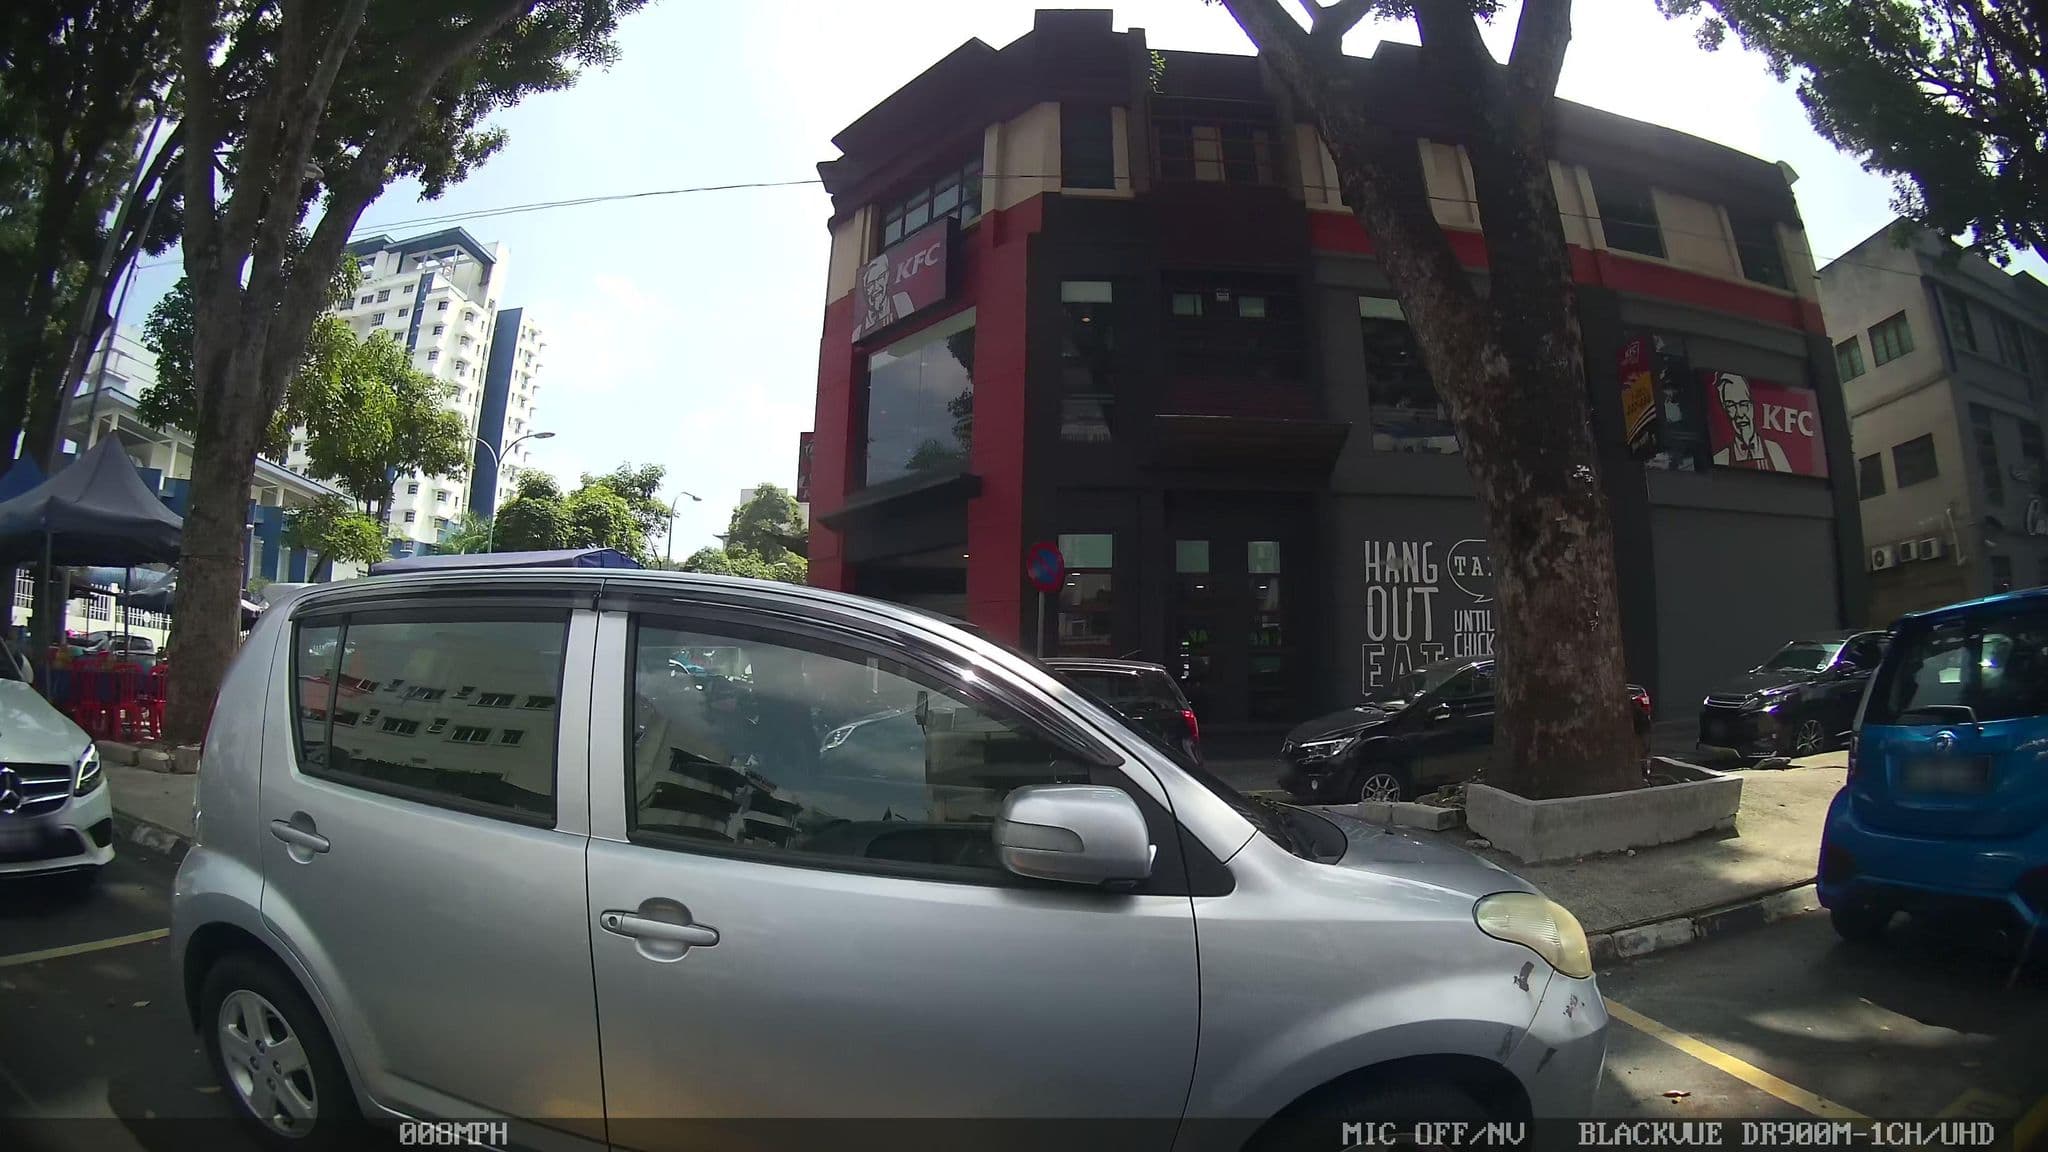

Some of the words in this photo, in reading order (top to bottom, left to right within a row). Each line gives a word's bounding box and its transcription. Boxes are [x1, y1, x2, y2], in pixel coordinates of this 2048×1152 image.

[895, 242, 941, 284] KFC
[1761, 403, 1815, 437] KFC
[1364, 540, 1438, 584] HANG
[1454, 556, 1492, 577] TA
[1366, 585, 1439, 642] OUT
[1454, 610, 1495, 633] UNTIL
